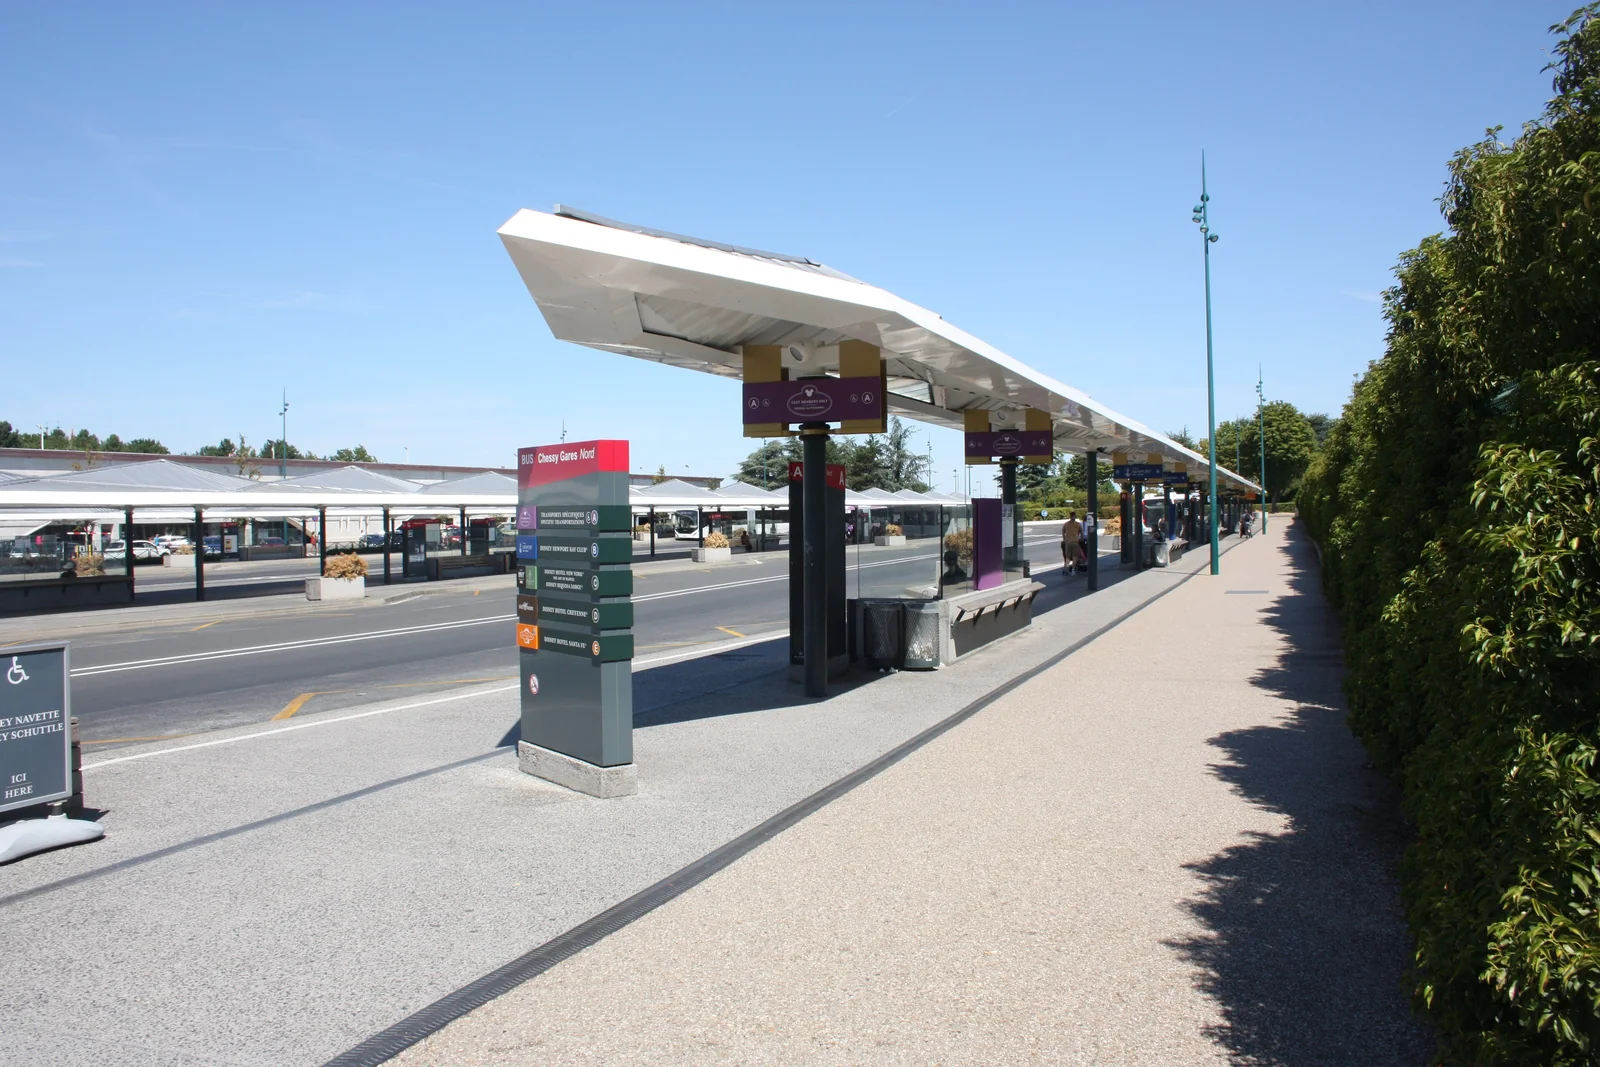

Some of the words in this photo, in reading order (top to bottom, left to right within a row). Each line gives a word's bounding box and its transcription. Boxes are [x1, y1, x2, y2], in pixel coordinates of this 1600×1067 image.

[522, 453, 534, 464] BUS
[538, 452, 559, 464] Chessy
[560, 450, 578, 462] Gares
[580, 447, 595, 459] Nord
[793, 466, 802, 477] A
[838, 470, 844, 486] A
[15, 710, 60, 724] NAVETTE
[11, 722, 64, 740] SCHUTTLE
[11, 772, 26, 784] ICI
[4, 785, 33, 799] HERE
